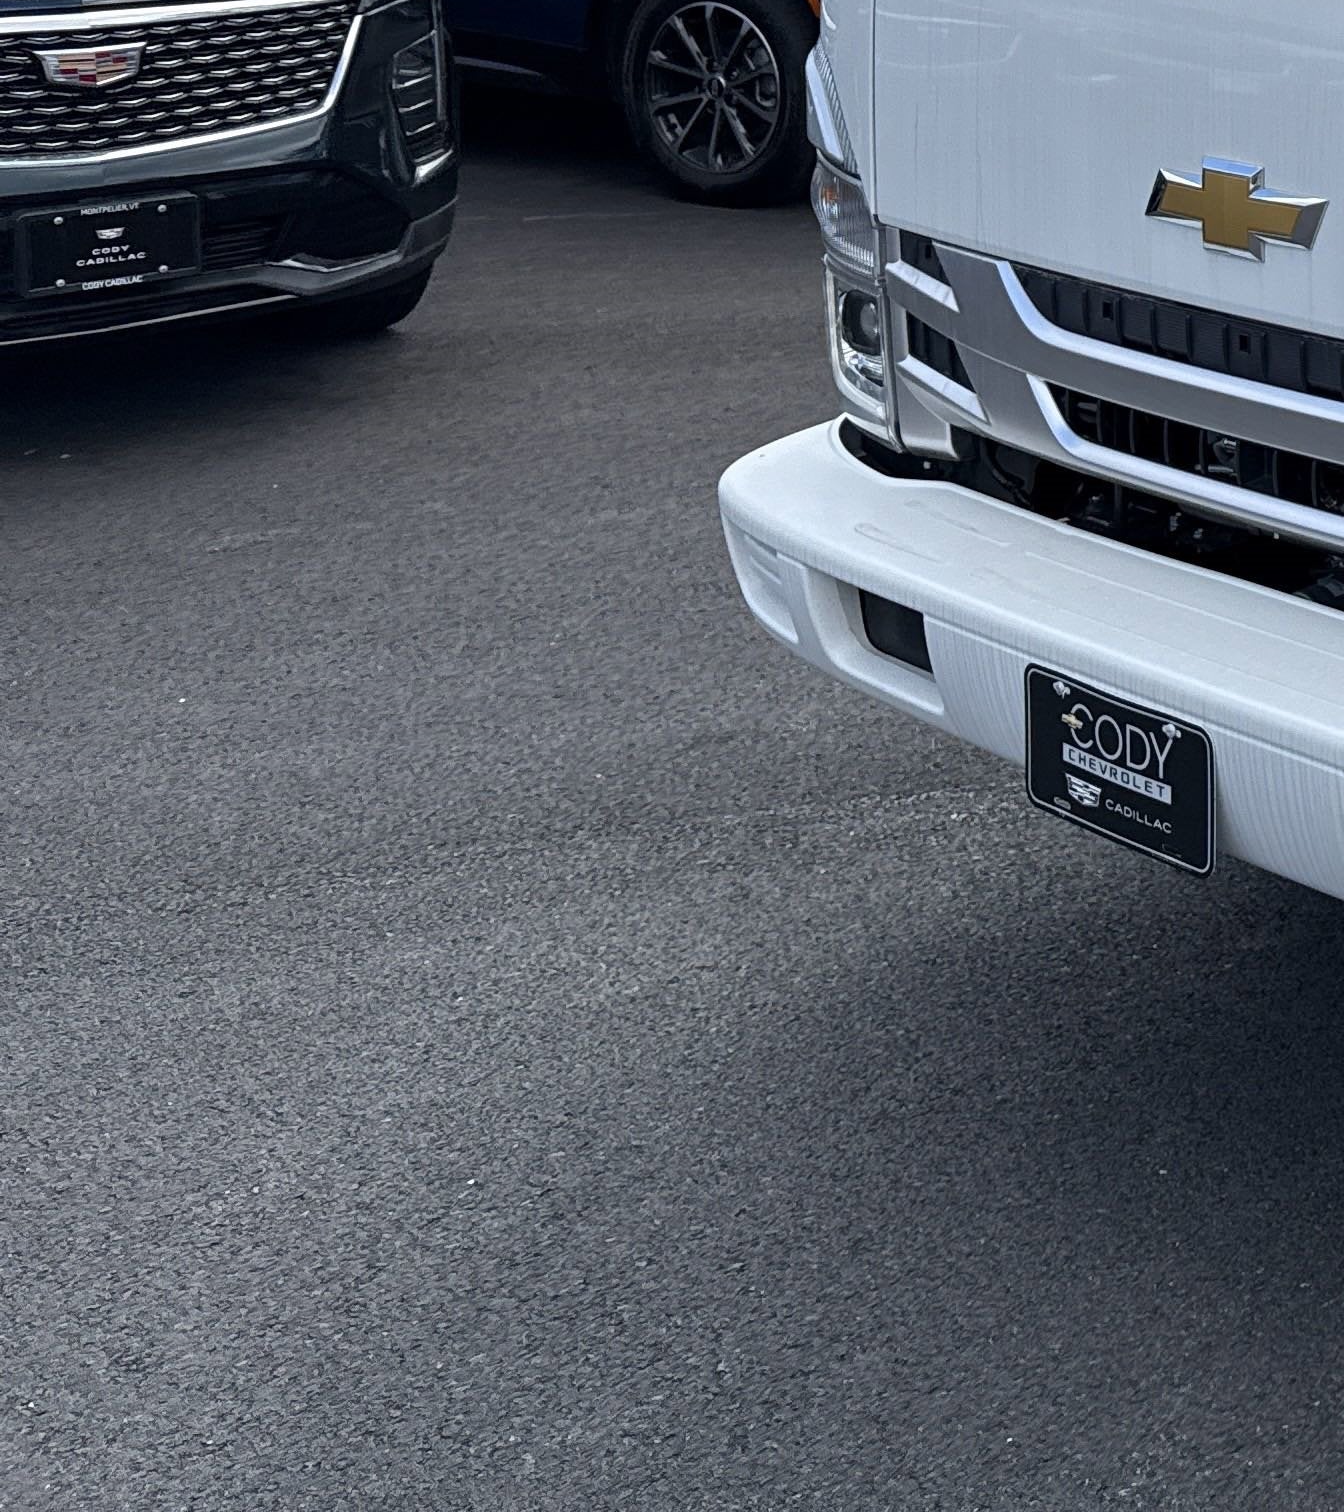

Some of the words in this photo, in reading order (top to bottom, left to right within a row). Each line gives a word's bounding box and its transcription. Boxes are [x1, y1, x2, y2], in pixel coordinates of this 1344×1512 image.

[76, 252, 146, 266] CADILLAC
[92, 245, 130, 255] CODY
[104, 274, 144, 288] CADILLAC
[1066, 702, 1174, 780] CODY
[1067, 747, 1167, 799] CHEVROLET
[1104, 798, 1173, 835] CADILLAC
